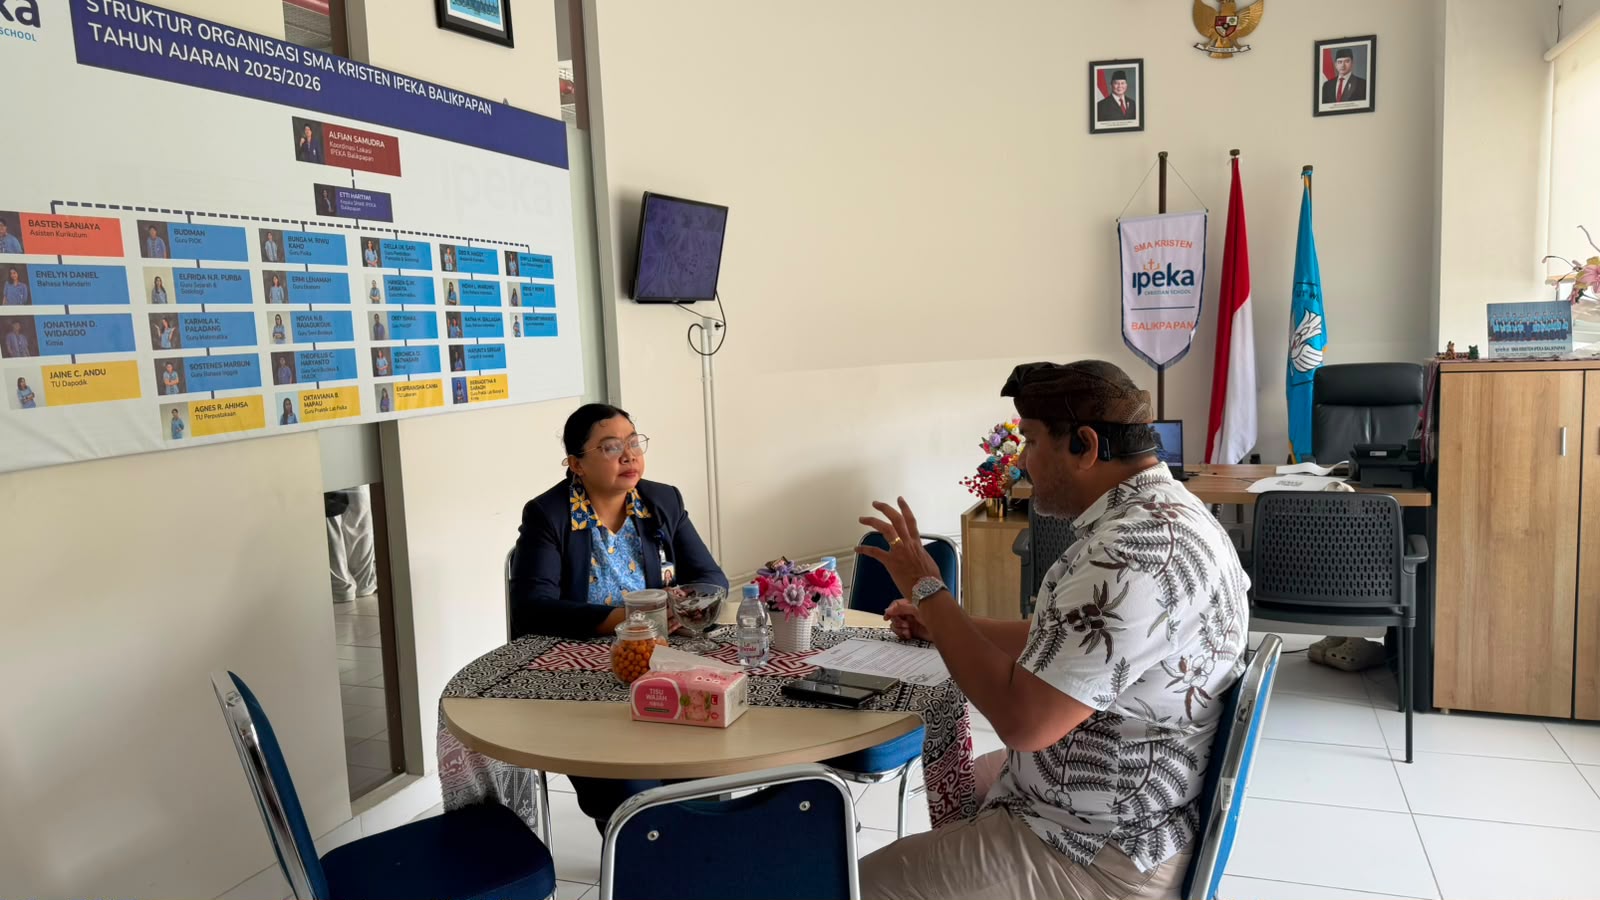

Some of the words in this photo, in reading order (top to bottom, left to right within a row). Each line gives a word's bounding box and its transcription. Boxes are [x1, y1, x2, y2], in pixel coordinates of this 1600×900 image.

[87, 0, 193, 36] STRUKTUR
[198, 23, 299, 63] ORGANISASI
[303, 51, 335, 72] SMA
[338, 60, 390, 88] KRISTEN
[393, 76, 427, 97] IPEKA
[428, 86, 492, 116] BALIKPAPAN
[88, 22, 163, 56] TAHUN
[169, 42, 239, 73] AJARAN
[244, 59, 321, 92] 2025/2026
[328, 131, 353, 143] ALFIAN
[353, 137, 386, 149] SAMUDRA
[28, 219, 63, 229] BASTEN
[64, 221, 101, 231] SANJAYA
[174, 228, 206, 237] BUDIMAN
[1133, 243, 1154, 253] SMA
[1154, 239, 1193, 250] KRISTEN
[36, 271, 68, 279] ENELYN
[69, 271, 100, 280] DANIEL
[1131, 262, 1195, 296] ipeka
[43, 320, 88, 329] JONATHAN
[89, 320, 97, 328] D.
[1131, 321, 1195, 331] BALIKPAPAN
[44, 329, 87, 338] WIDAGDO
[49, 370, 72, 380] JAINE
[73, 369, 82, 378] C.
[83, 368, 107, 377] ANDU
[194, 405, 217, 413] AGNES
